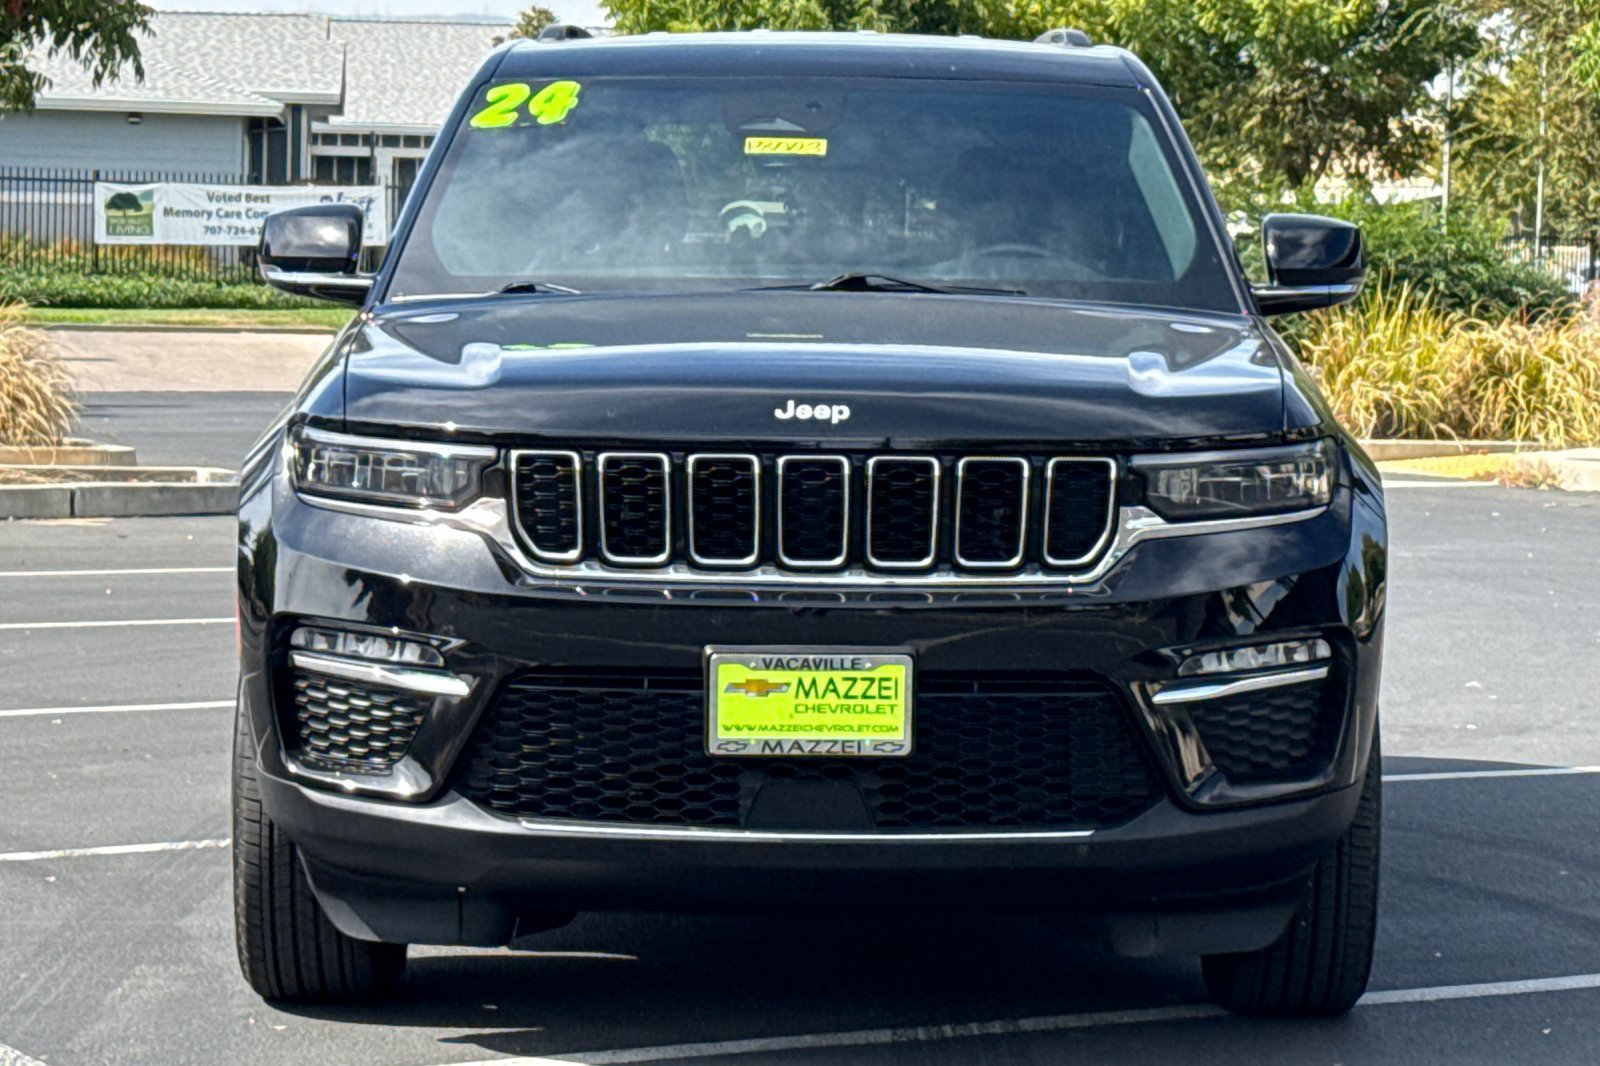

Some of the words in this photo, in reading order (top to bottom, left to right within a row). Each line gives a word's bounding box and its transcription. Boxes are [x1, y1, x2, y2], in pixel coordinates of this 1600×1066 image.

[470, 81, 581, 128] 24
[206, 191, 242, 203] Voted
[244, 192, 271, 204] Best
[163, 206, 213, 220] Memory
[216, 207, 242, 219] Care
[774, 399, 851, 424] Jeep
[761, 657, 864, 671] VACAVILLE
[794, 676, 899, 700] MAZZEI
[794, 703, 899, 715] CHEVROLET
[761, 740, 863, 755] MAZZEI
